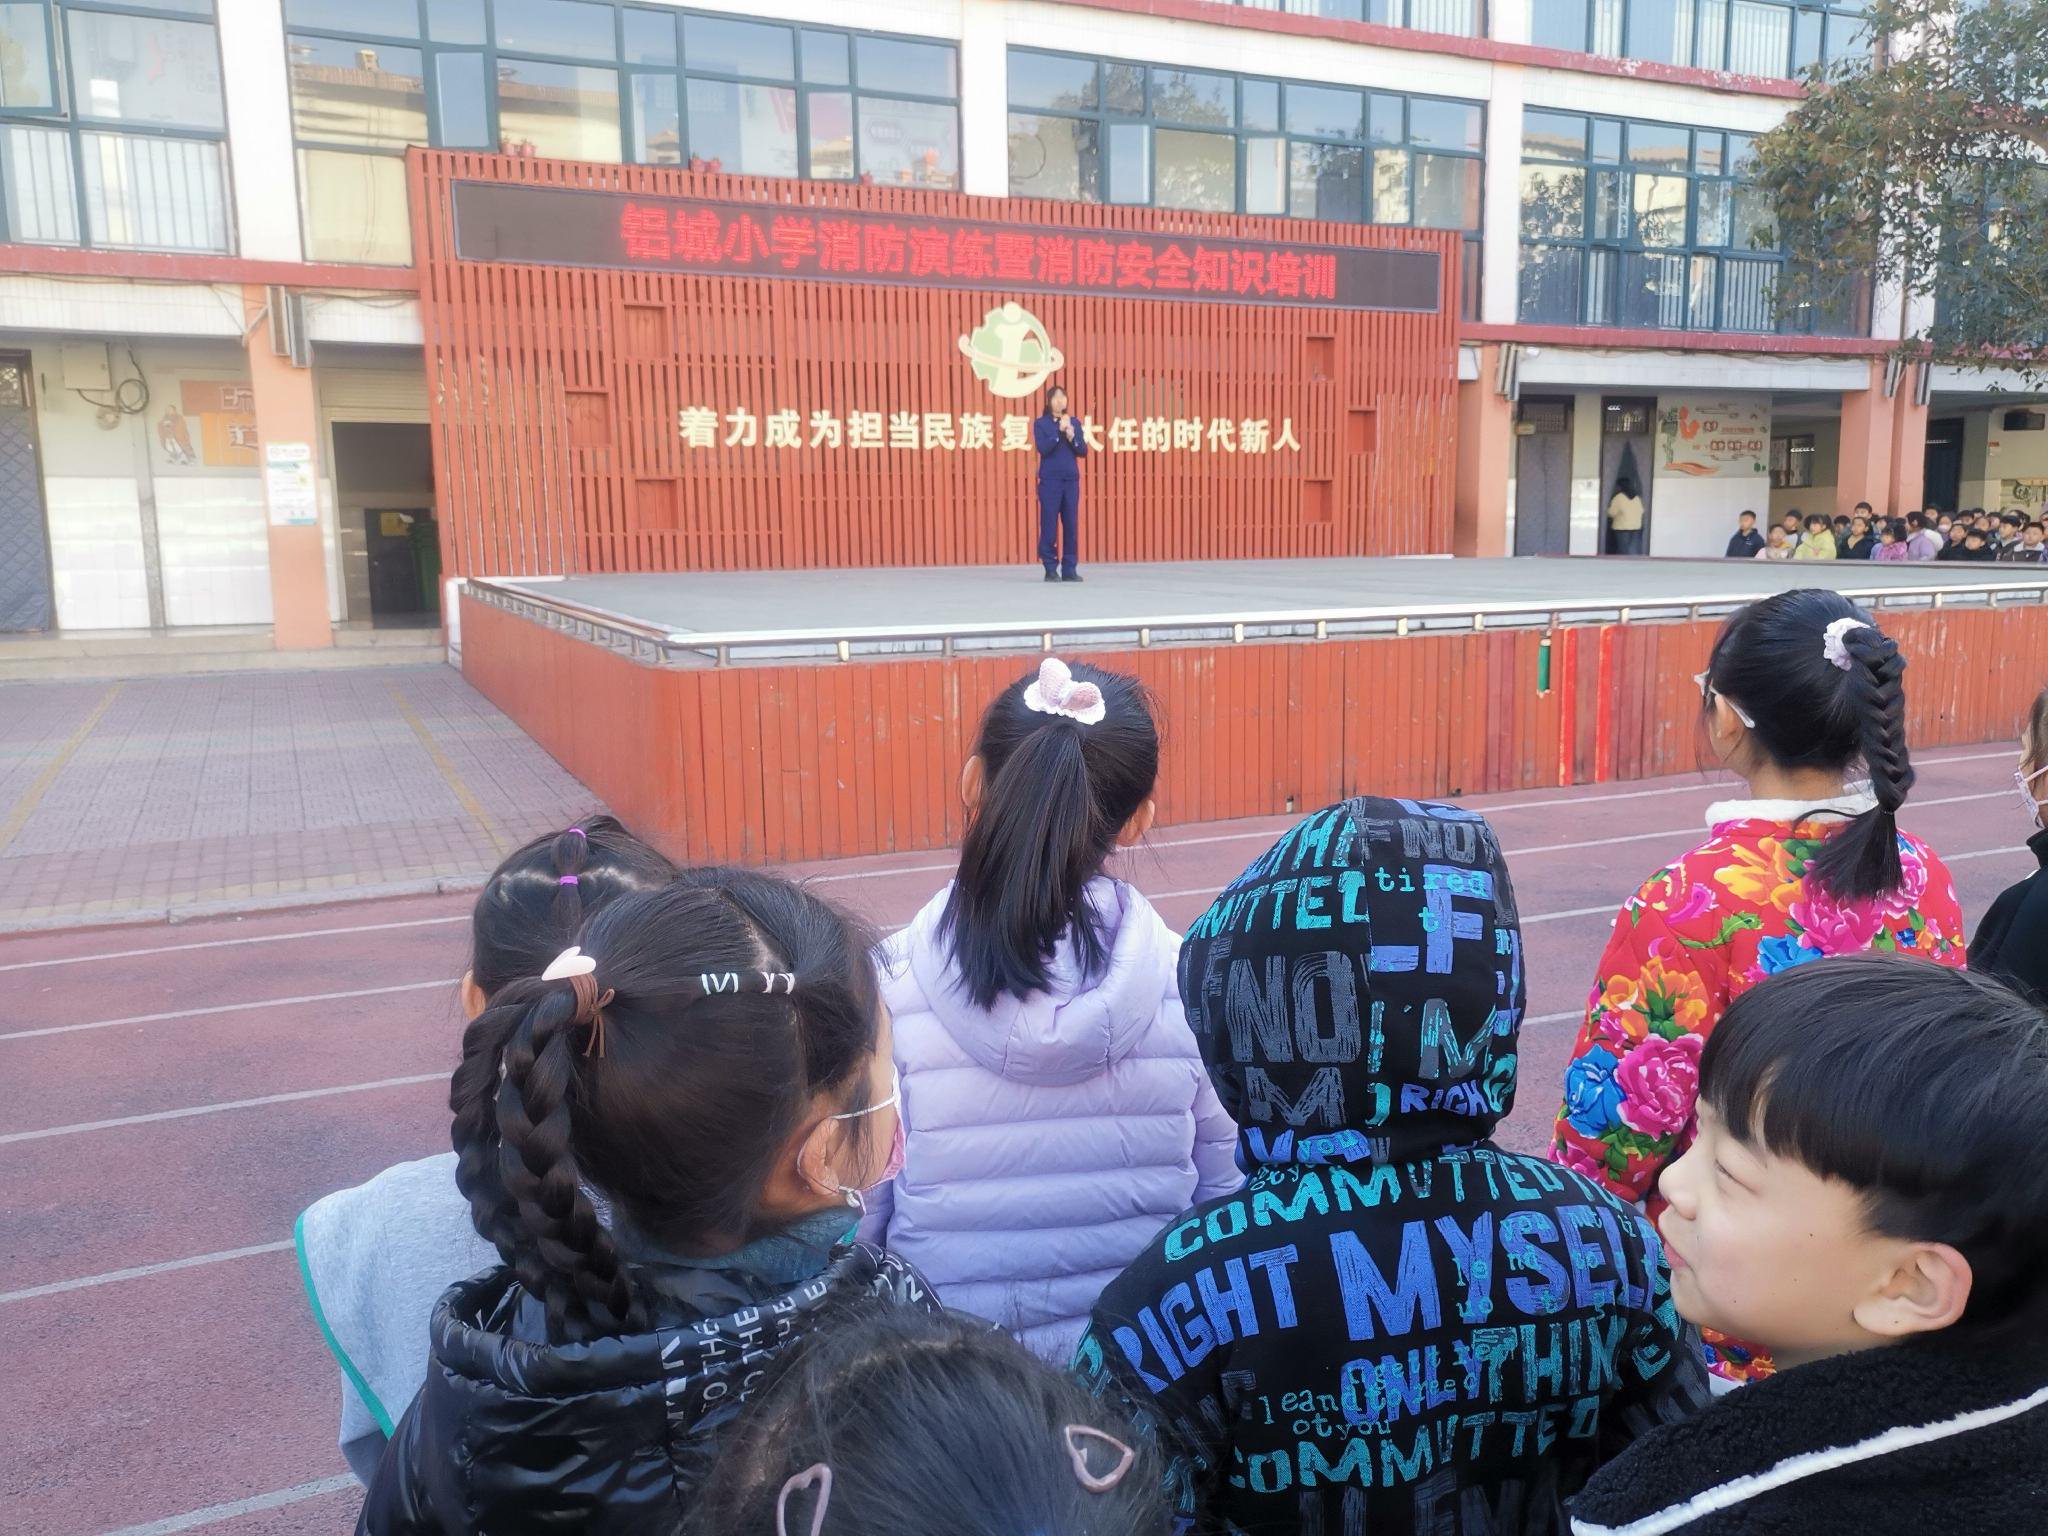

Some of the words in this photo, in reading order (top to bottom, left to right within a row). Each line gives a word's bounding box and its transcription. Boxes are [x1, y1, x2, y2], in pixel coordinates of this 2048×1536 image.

[620, 202, 1336, 300] 铝城小学消防演练暨消防安全知识培训
[679, 405, 1302, 454] 着力成为担当民族复大任的时代新人
[1112, 1244, 1299, 1394] RIGHT
